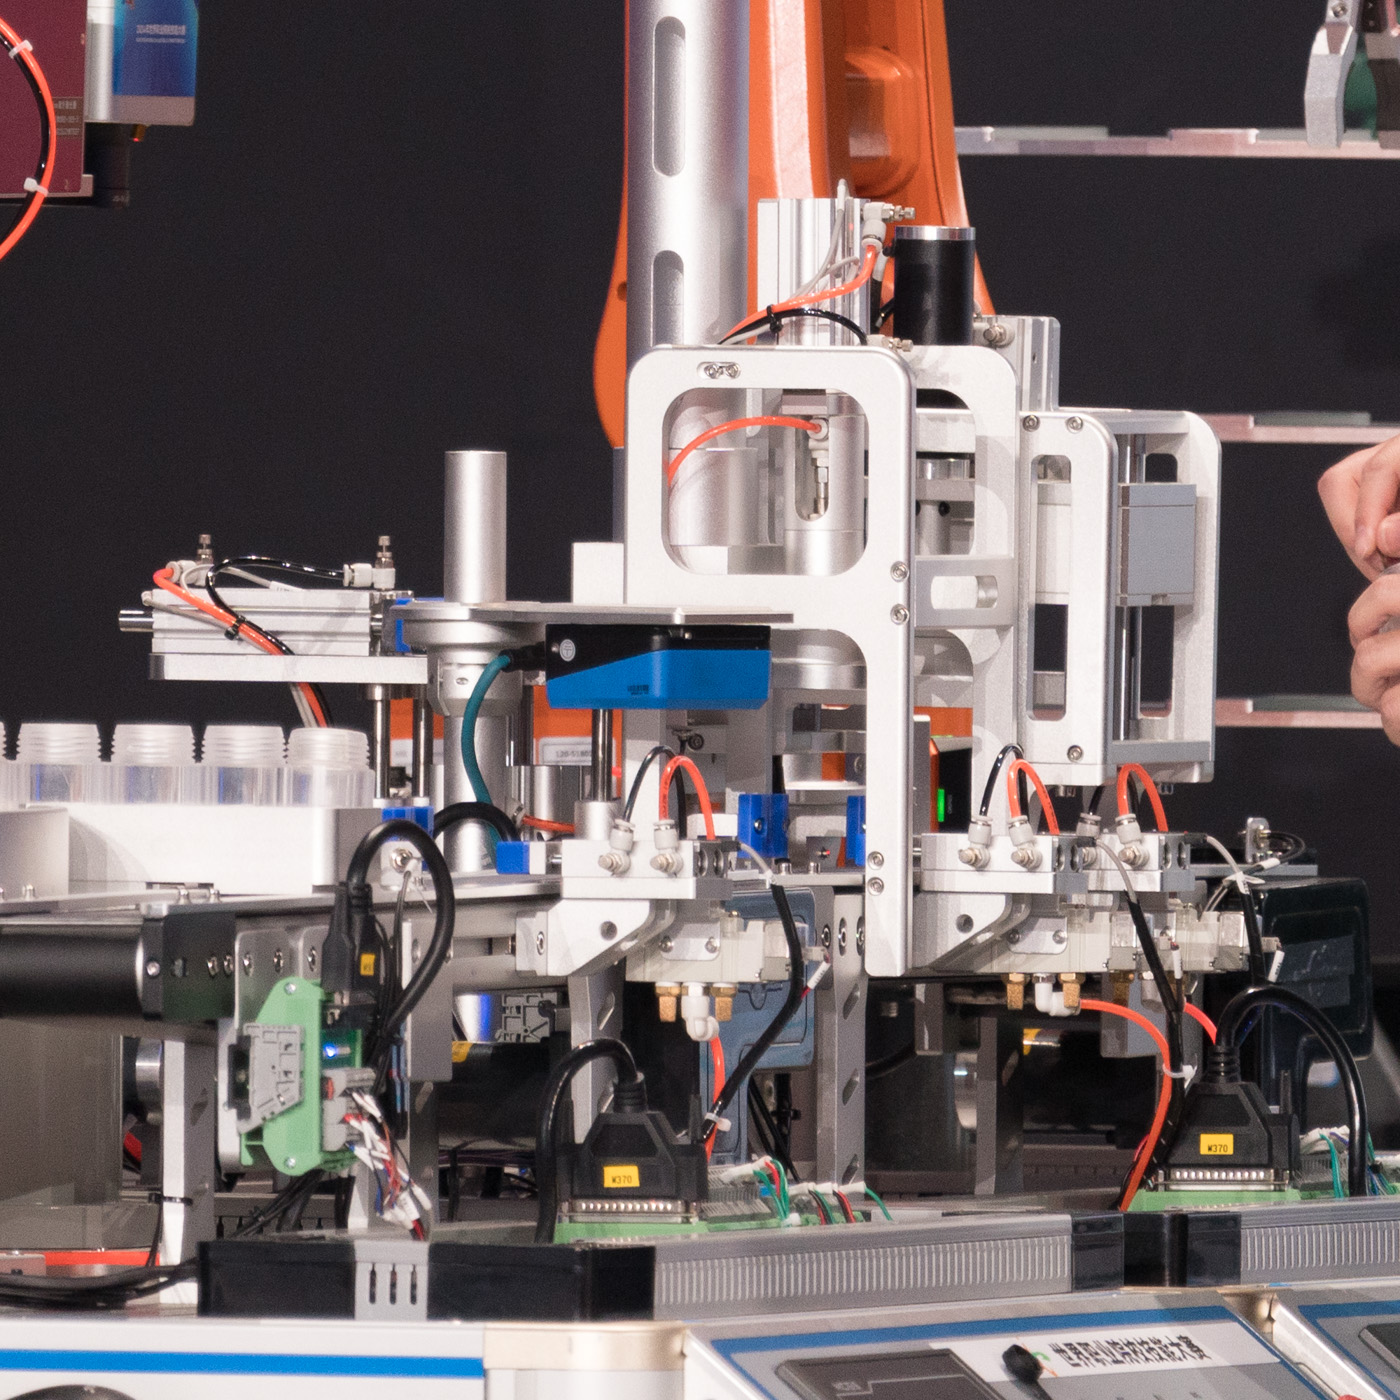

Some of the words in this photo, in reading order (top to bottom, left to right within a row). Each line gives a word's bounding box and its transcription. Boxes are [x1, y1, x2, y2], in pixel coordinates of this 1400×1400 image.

[1047, 1333, 1213, 1368] 世界职业院校技能大赛
